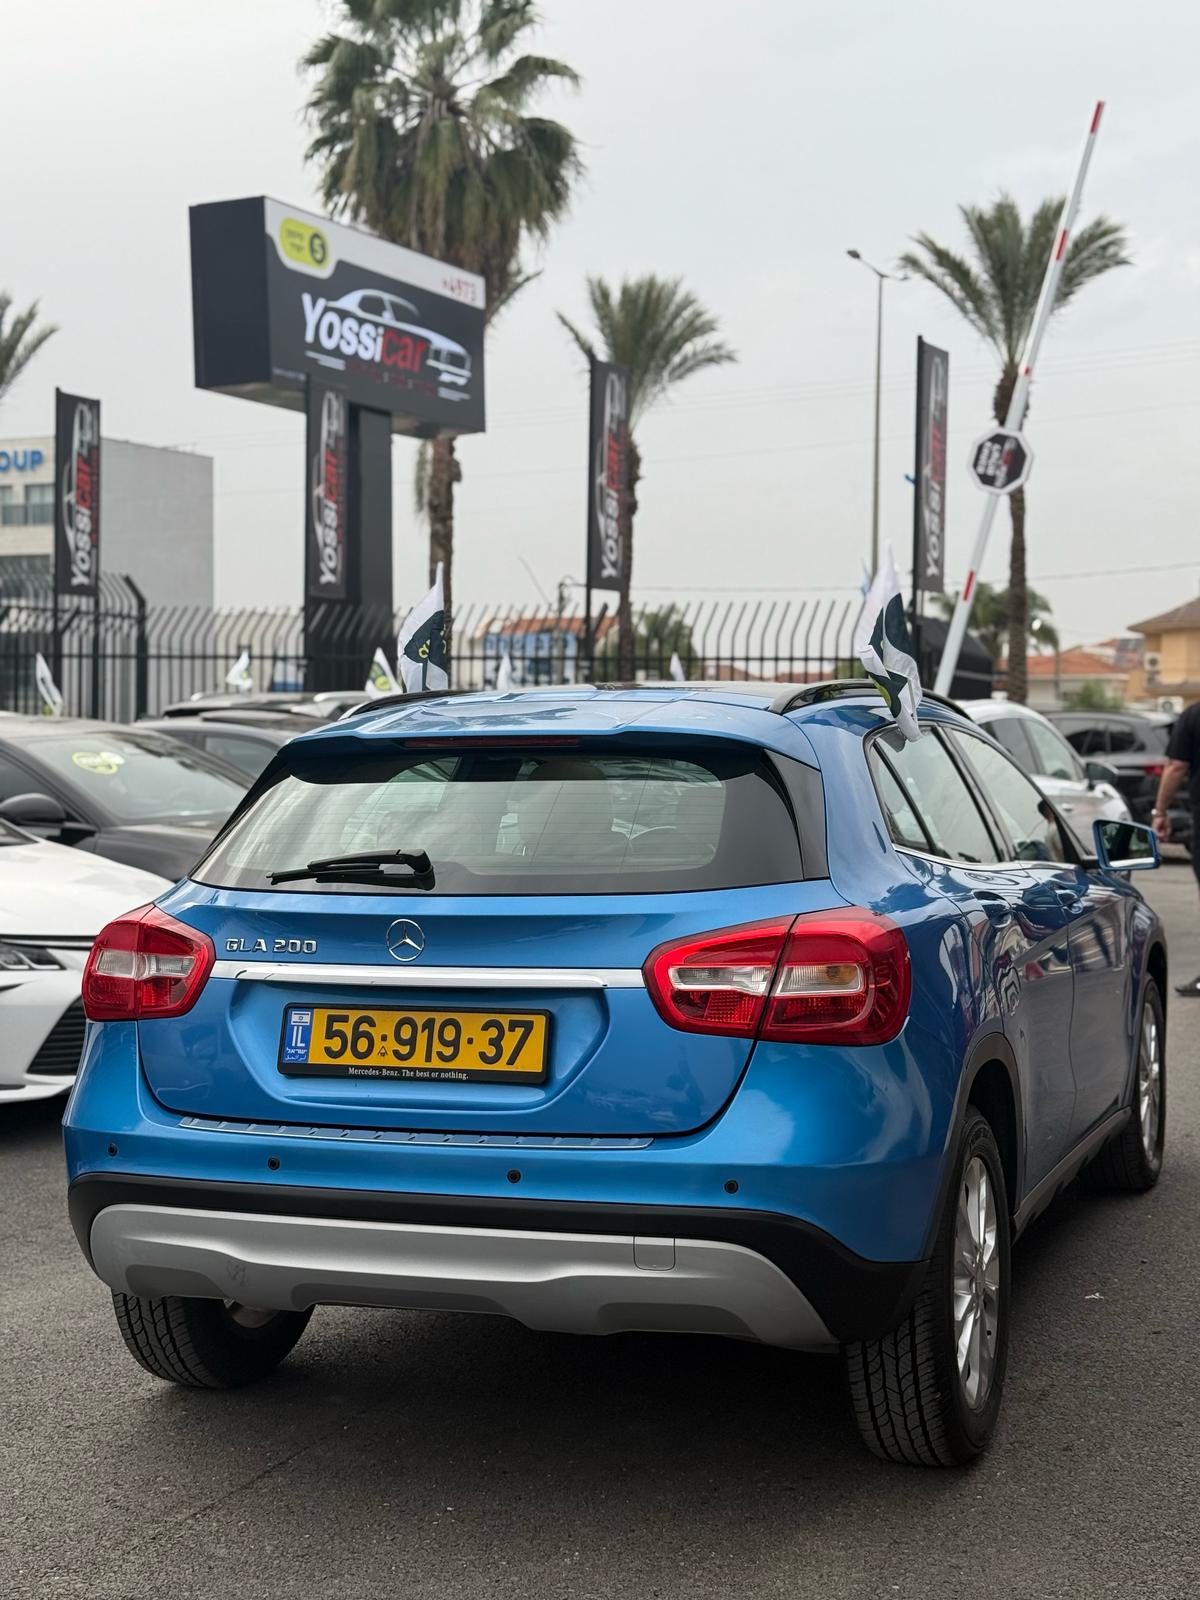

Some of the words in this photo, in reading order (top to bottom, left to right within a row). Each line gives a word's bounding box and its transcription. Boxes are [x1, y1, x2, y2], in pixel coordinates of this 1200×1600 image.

[226, 938, 267, 952] GLA
[273, 939, 317, 953] 200
[292, 1026, 306, 1047] IL
[348, 1067, 400, 1076] Mercedes-Benz.
[402, 1069, 414, 1077] The
[440, 1071, 468, 1080] nothing.
